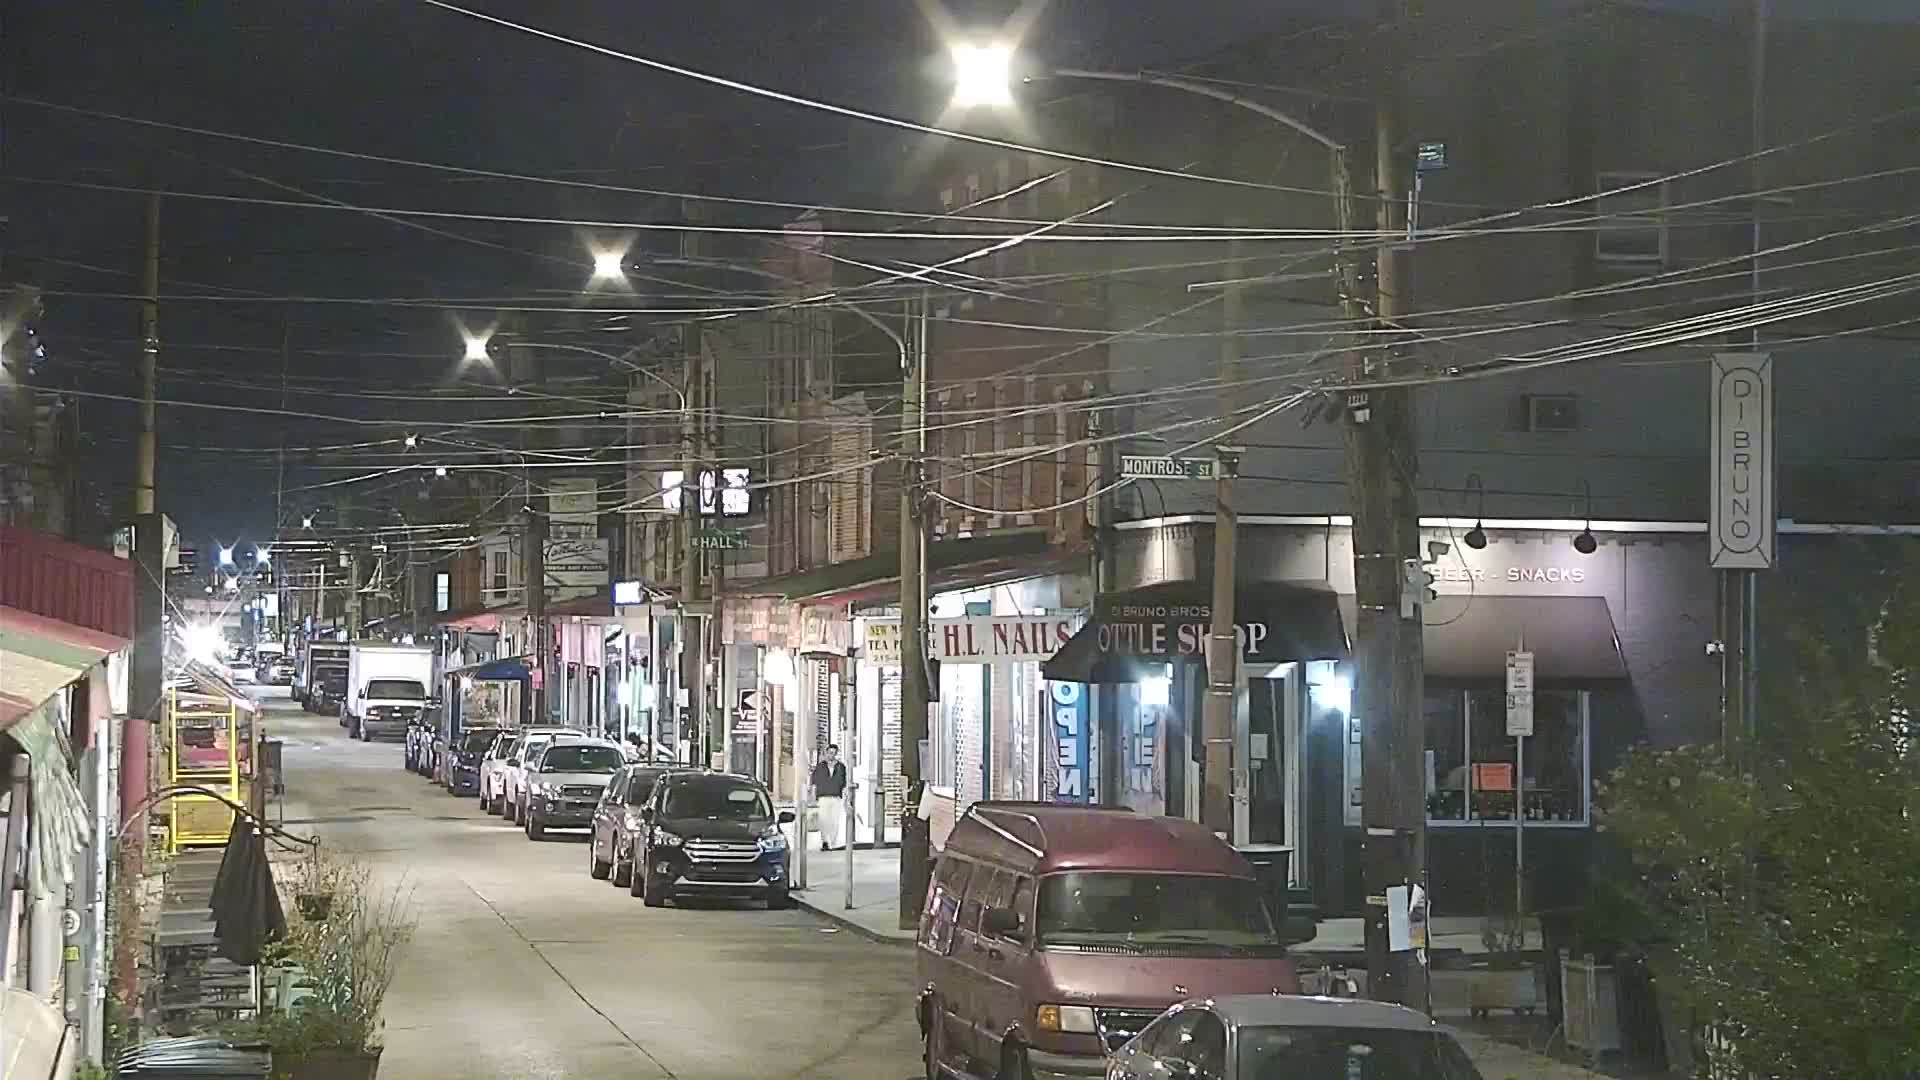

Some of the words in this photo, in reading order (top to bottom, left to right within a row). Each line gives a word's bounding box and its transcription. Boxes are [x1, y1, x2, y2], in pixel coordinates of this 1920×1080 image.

[1123, 460, 1191, 475] MONTROSE
[1199, 464, 1210, 476] ST
[1731, 431, 1750, 539] BRUNO
[700, 536, 734, 549] HALL
[1430, 568, 1485, 582] BEER
[1507, 568, 1584, 583] SNACKS
[1123, 606, 1166, 617] BRUNO
[1169, 606, 1211, 617] BROS
[868, 640, 889, 651] TEA
[943, 624, 984, 657] H.L.
[991, 621, 1070, 656] NAILS
[1097, 623, 1166, 654] OTTLE
